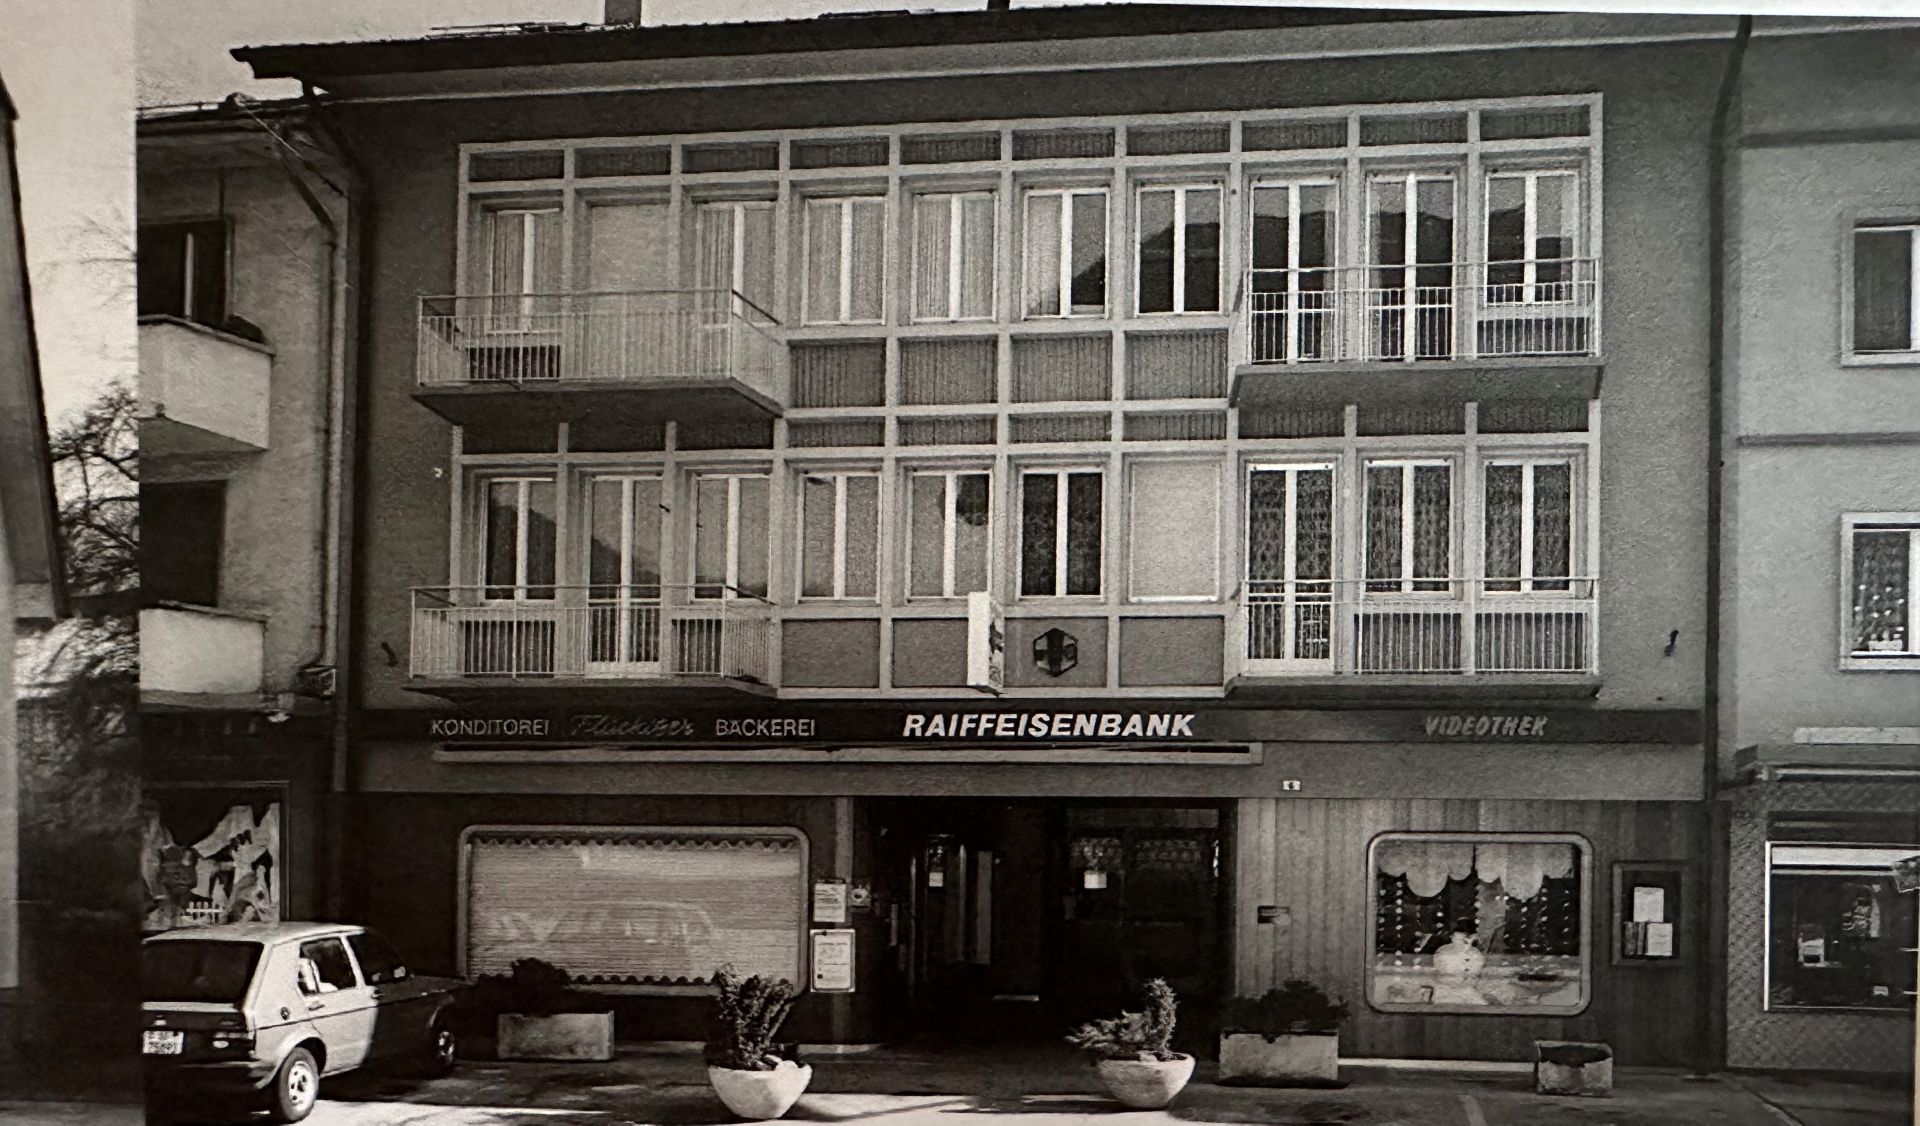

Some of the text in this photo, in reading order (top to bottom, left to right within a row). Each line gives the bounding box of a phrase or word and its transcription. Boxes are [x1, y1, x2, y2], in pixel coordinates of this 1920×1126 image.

[430, 718, 550, 736] KONDITOREI
[903, 713, 1196, 737] RAIFFEISENBANK
[1425, 714, 1549, 737] VIDEOTHEK
